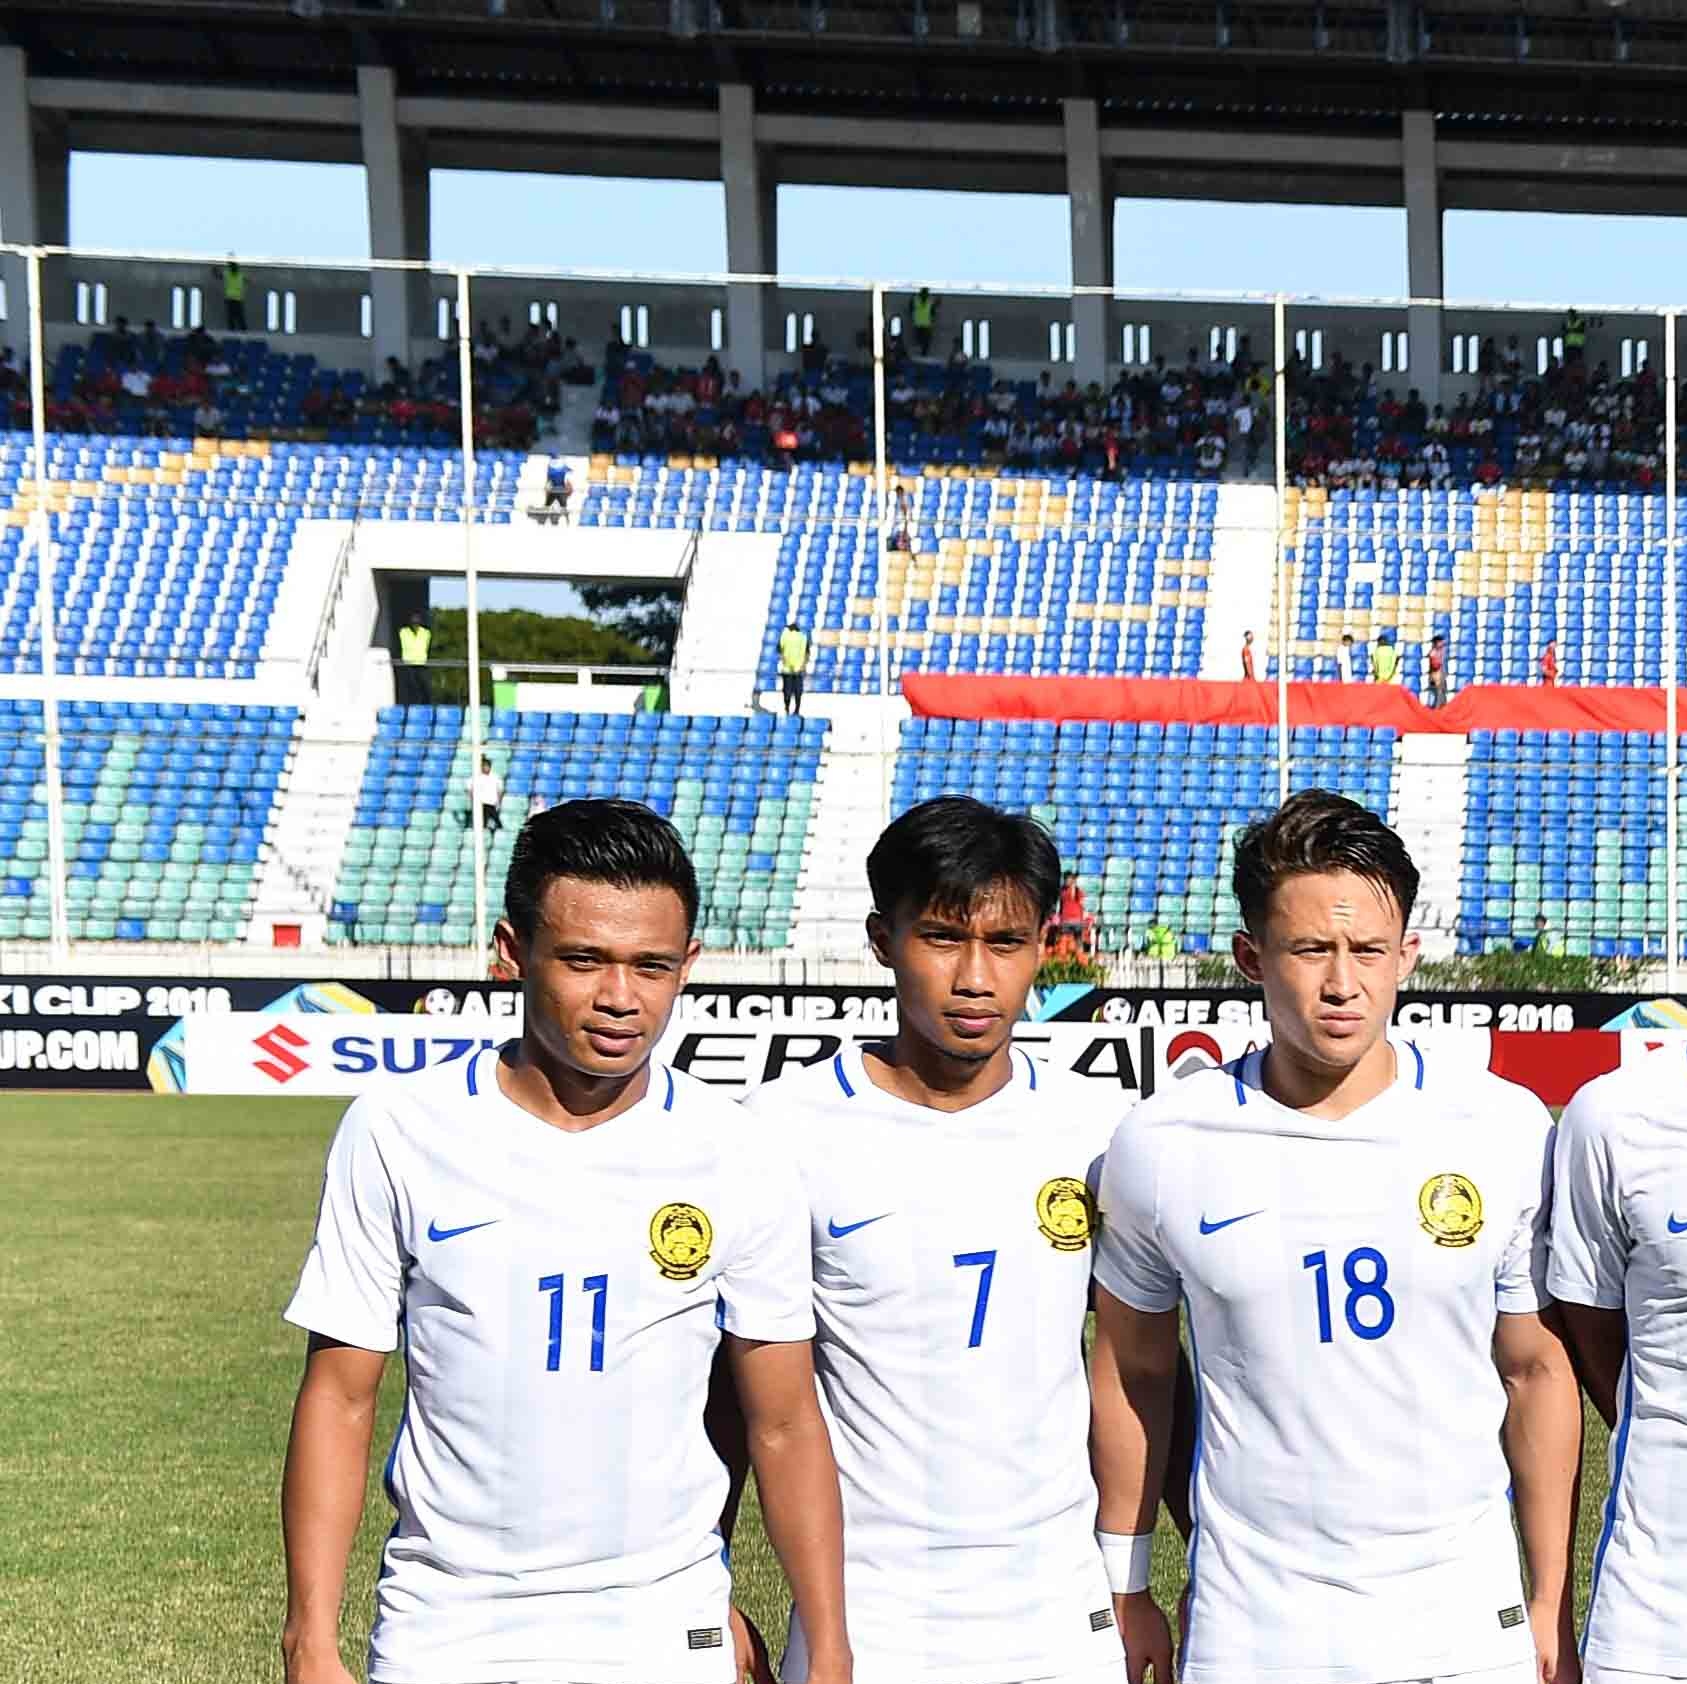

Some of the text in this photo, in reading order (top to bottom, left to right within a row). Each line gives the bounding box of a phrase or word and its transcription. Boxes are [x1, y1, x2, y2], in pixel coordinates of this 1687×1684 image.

[33, 985, 141, 1015] CUP
[736, 995, 836, 1021] CUP
[1137, 1000, 1212, 1025] AFF
[1398, 1003, 1575, 1032] CUP 2016
[332, 1037, 493, 1073] SUZ
[952, 1248, 997, 1348] 7
[1302, 1246, 1396, 1344] 18
[538, 1273, 609, 1373] 11
